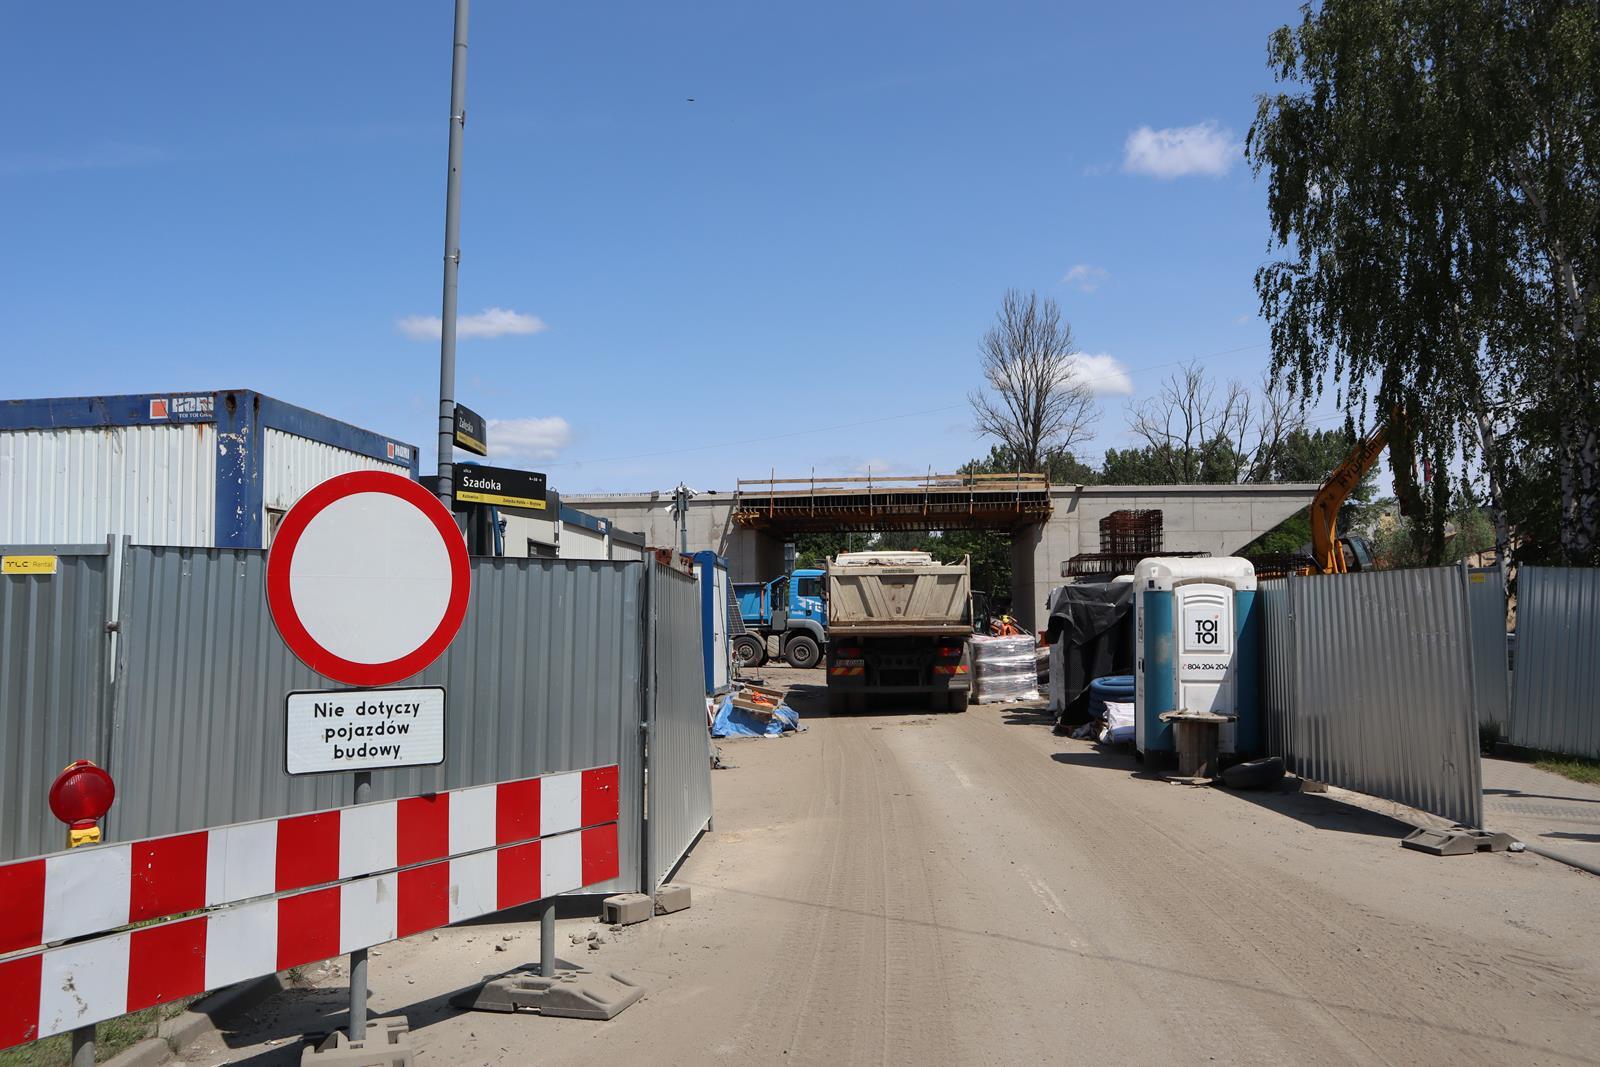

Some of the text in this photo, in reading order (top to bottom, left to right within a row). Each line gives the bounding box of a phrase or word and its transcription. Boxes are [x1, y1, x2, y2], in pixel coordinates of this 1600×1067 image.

[463, 476, 502, 491] Szadoka
[1195, 620, 1218, 632] TOI
[1195, 632, 1218, 644] TOI
[314, 701, 420, 719] Nie dotyczy
[325, 720, 410, 743] pojazdów
[334, 742, 401, 759] budowy
